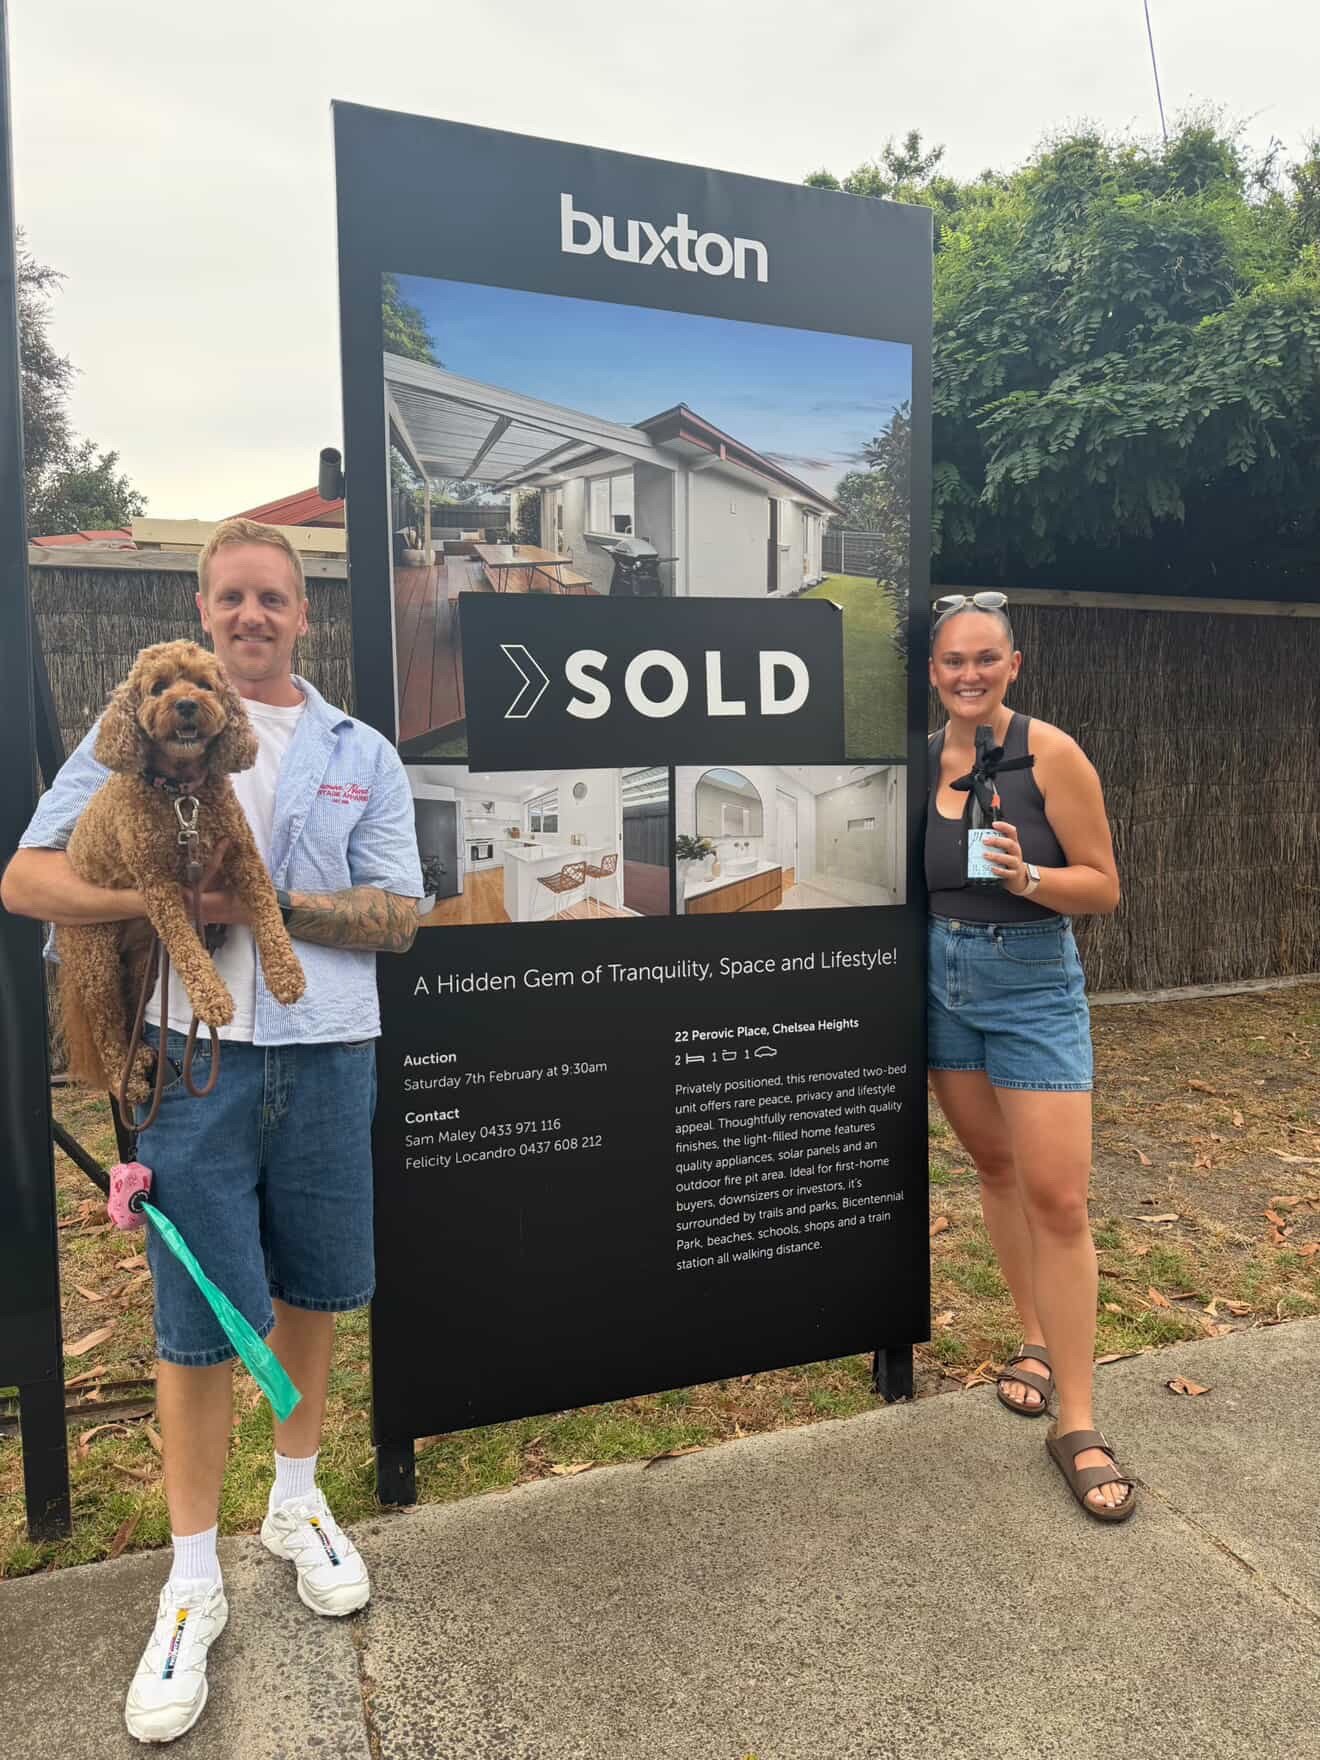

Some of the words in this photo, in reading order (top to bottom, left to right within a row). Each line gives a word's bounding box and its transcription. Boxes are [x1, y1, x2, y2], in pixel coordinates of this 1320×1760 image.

[561, 192, 768, 282] buxton
[565, 649, 810, 719] SOLD
[414, 976, 430, 995] A
[438, 972, 516, 993] Hidden
[523, 969, 574, 988] Gem
[581, 964, 602, 984] of
[607, 959, 712, 983] Tranquility,
[719, 957, 776, 979] Space
[780, 952, 814, 971] and
[821, 948, 896, 970] Lifestyle!
[674, 1030, 688, 1042] 22
[692, 1027, 734, 1040] Perovic
[737, 1026, 770, 1037] Place,
[772, 1022, 815, 1034] Chelsea
[818, 1018, 859, 1031] Heights
[403, 1052, 456, 1066] Auction
[675, 1055, 681, 1066] 2
[712, 1051, 717, 1062] 1
[744, 1049, 750, 1060] 1
[404, 1075, 461, 1091] Saturday
[464, 1072, 485, 1084] 7th
[489, 1069, 543, 1082] February
[546, 1066, 558, 1077] at
[561, 1062, 607, 1075] 9:30am
[675, 1081, 722, 1095] Privately
[724, 1075, 784, 1092] positioned,
[786, 1073, 806, 1084] this
[808, 1068, 860, 1082] renovated
[862, 1064, 906, 1077] two-bed
[675, 1103, 697, 1114] unit
[699, 1099, 731, 1112] offers
[734, 1098, 756, 1107] rare
[758, 1095, 792, 1107] peace,
[796, 1091, 833, 1104] privacy
[835, 1087, 855, 1098] and
[857, 1083, 896, 1096] lifestyle
[404, 1108, 460, 1124] Contact
[717, 1111, 786, 1128] Thoughtfully
[788, 1106, 842, 1120] renovated
[844, 1103, 866, 1115] with
[868, 1101, 902, 1114] quality
[405, 1135, 434, 1147] Sam
[438, 1129, 476, 1143] Maley
[479, 1123, 512, 1138] 0433
[515, 1121, 537, 1134] 971
[541, 1118, 560, 1131] 116
[675, 1140, 720, 1152] finishes,
[722, 1136, 741, 1147] the
[743, 1129, 798, 1147] light-filled
[800, 1127, 832, 1138] home
[834, 1122, 876, 1134] features
[406, 1154, 451, 1169] Felicity
[455, 1147, 516, 1163] Locandro
[519, 1140, 551, 1155] 0437
[554, 1137, 578, 1151] 608
[581, 1135, 602, 1148] 212
[675, 1159, 712, 1174] quality
[715, 1153, 775, 1169] appliances,
[778, 1148, 804, 1160] solar
[806, 1143, 840, 1159] panels
[842, 1141, 862, 1152] and
[864, 1141, 877, 1150] an
[675, 1178, 721, 1192] outdoor
[724, 1175, 742, 1185] fire
[744, 1172, 758, 1186] pit
[761, 1170, 786, 1181] area.
[790, 1164, 815, 1177] Ideal
[817, 1163, 832, 1174] for
[835, 1158, 890, 1171] first-home
[676, 1199, 716, 1212] buyers,
[718, 1190, 779, 1206] downsizers
[781, 1188, 794, 1197] or
[796, 1182, 846, 1195] investors,
[676, 1212, 740, 1231] surrounded
[743, 1211, 756, 1223] by
[758, 1207, 784, 1219] trails
[785, 1203, 806, 1216] and
[809, 1200, 839, 1215] parks,
[842, 1190, 904, 1208] Bicentennial
[676, 1237, 703, 1250] Park,
[706, 1231, 755, 1246] beaches,
[757, 1224, 802, 1239] schools,
[804, 1220, 835, 1232] shops
[837, 1215, 857, 1227] and
[859, 1216, 866, 1224] a
[868, 1211, 890, 1222] train
[676, 1257, 714, 1270] station
[716, 1252, 729, 1264] all
[732, 1247, 773, 1261] walking
[775, 1240, 822, 1255] distance.
